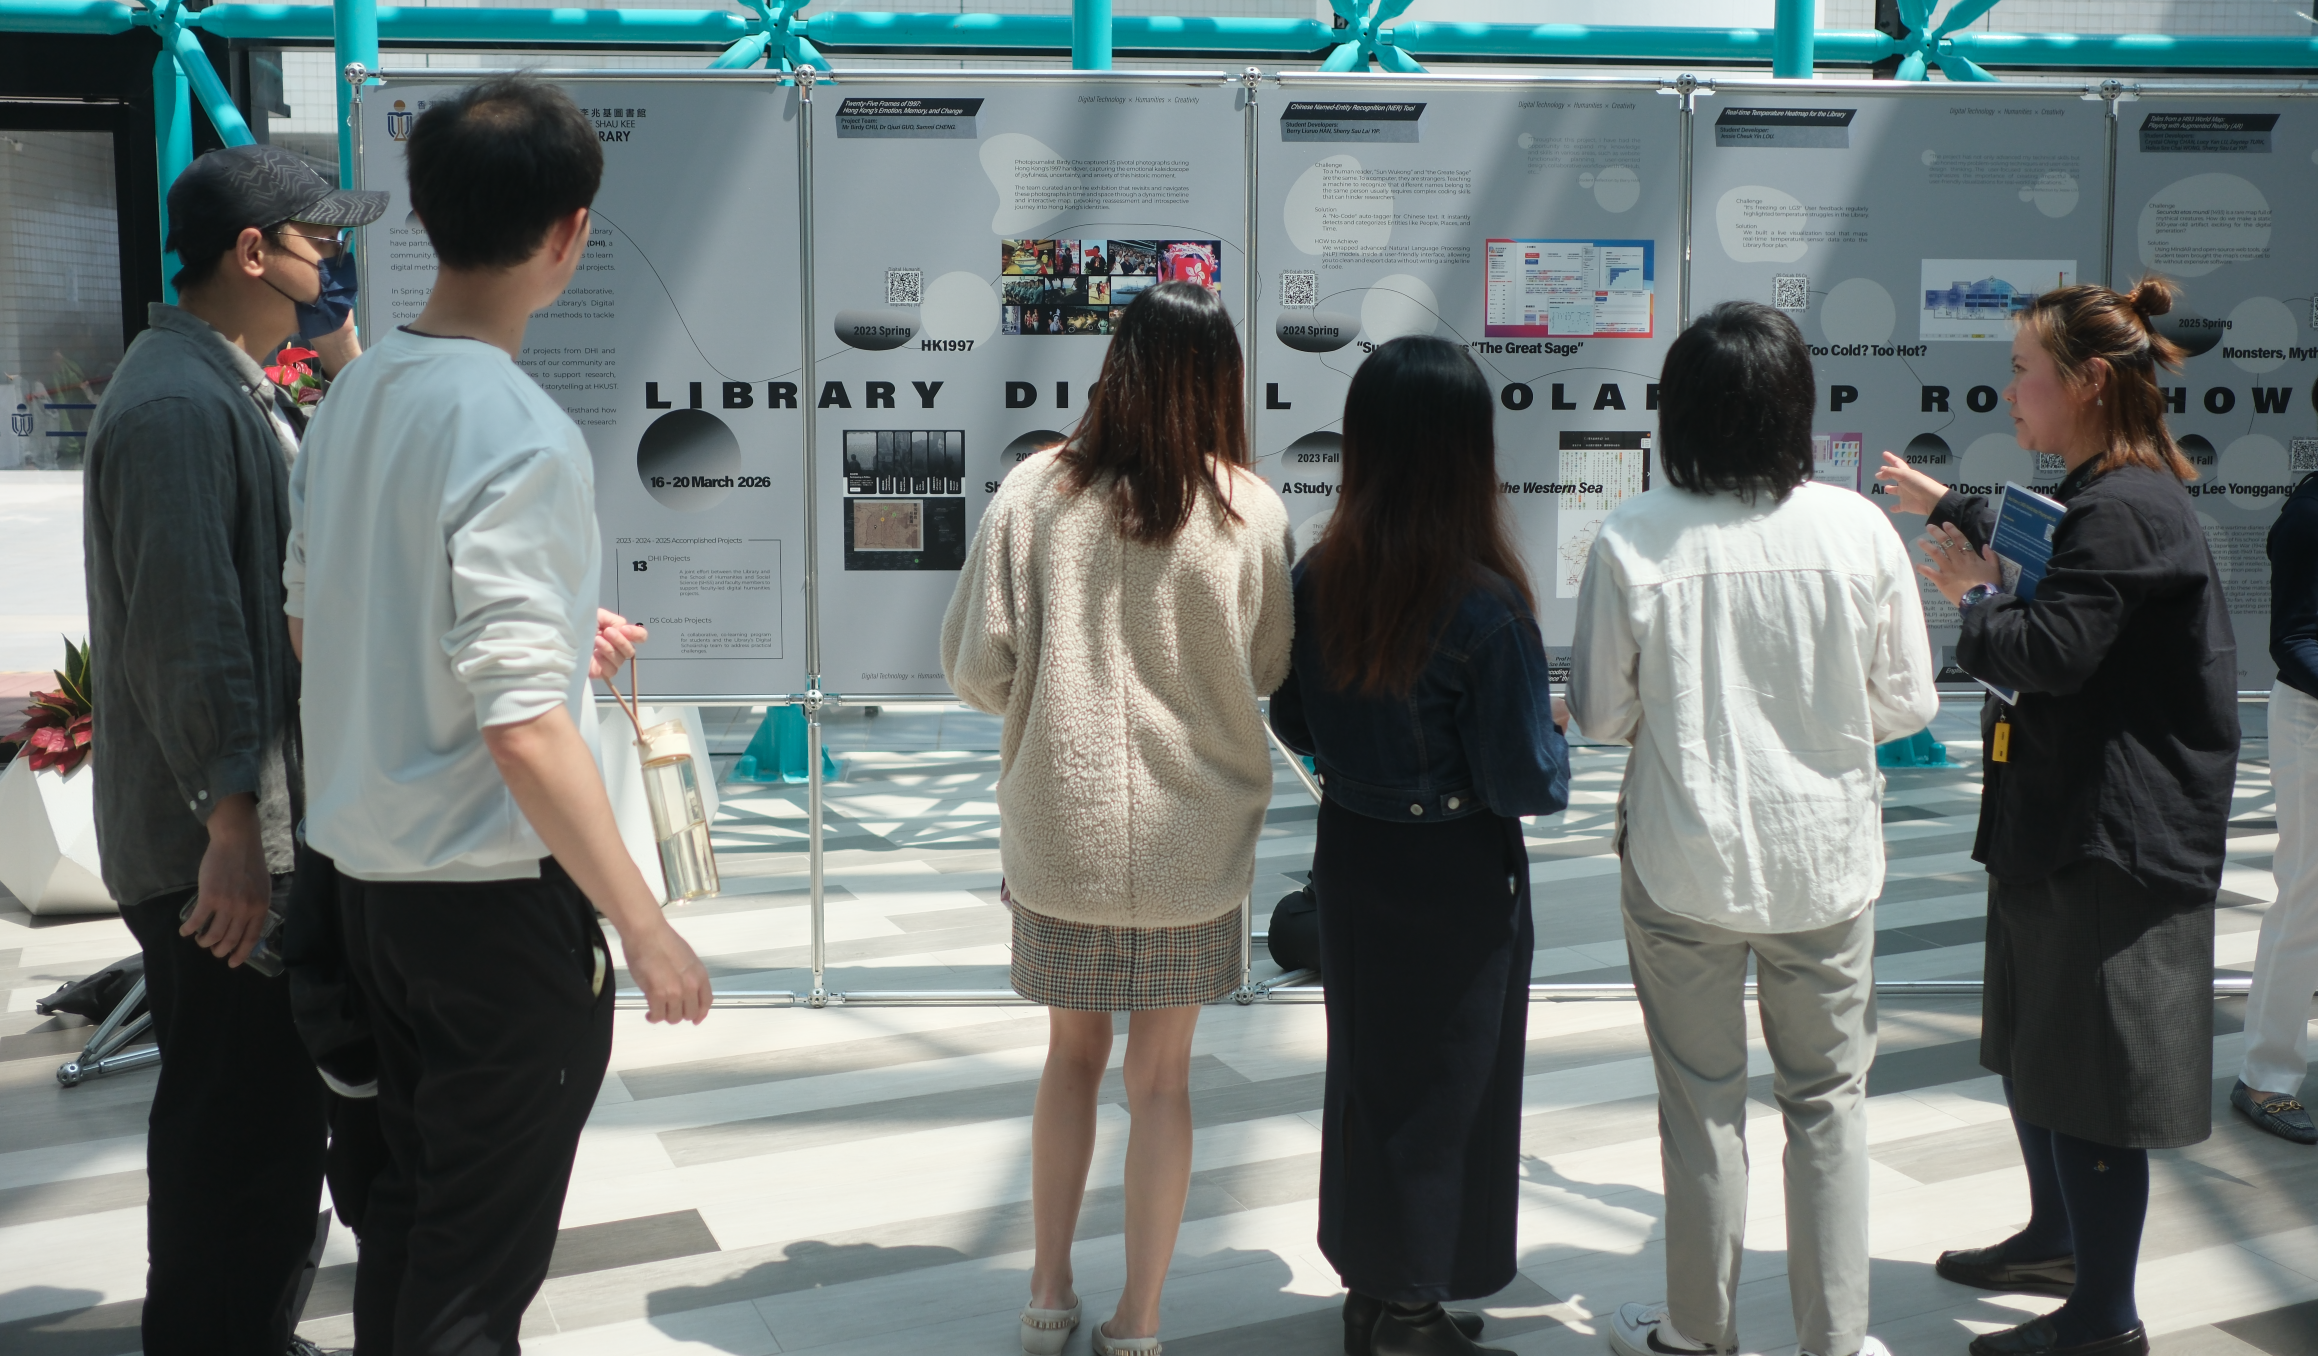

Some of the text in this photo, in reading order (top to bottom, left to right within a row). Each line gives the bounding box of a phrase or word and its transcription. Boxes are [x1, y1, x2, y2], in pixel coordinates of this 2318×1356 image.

[1078, 96, 1095, 104] Digital
[1096, 96, 1126, 104] Technology
[1174, 96, 1200, 104] Creativity
[1536, 101, 1565, 110] Technology
[1611, 102, 1636, 110] Creativity
[595, 120, 618, 128] SHAU
[621, 120, 635, 128] KEE
[599, 131, 631, 142] RARY
[586, 264, 615, 272] projects.
[400, 288, 424, 296] Spring
[591, 300, 614, 308] Digital
[2178, 318, 2232, 330] 2025 Spring
[854, 325, 910, 338] 2023 Spring
[1283, 326, 1339, 337] 2024 Spring
[921, 340, 974, 352] HK1997
[1506, 342, 1542, 353] Great
[1806, 345, 1927, 357] Too Cold? Too Hot?
[2223, 347, 2286, 360] Monsters,
[545, 383, 583, 391] storytelling
[645, 382, 945, 409] LIBRARY
[1297, 454, 1340, 463] 2023 Fall
[1906, 454, 1946, 464] 2024 Fall
[2197, 456, 2213, 465] Fall
[651, 476, 665, 488] 16
[673, 476, 690, 488] 20
[692, 475, 734, 488] March
[738, 476, 771, 488] 2026
[1282, 482, 1333, 496] A Study
[1500, 482, 1603, 494] the Western Sea
[1960, 484, 1992, 495] Docs
[2202, 483, 2297, 497] Lee Yonggang'
[632, 561, 648, 572] 13
[684, 617, 712, 625] Projects
